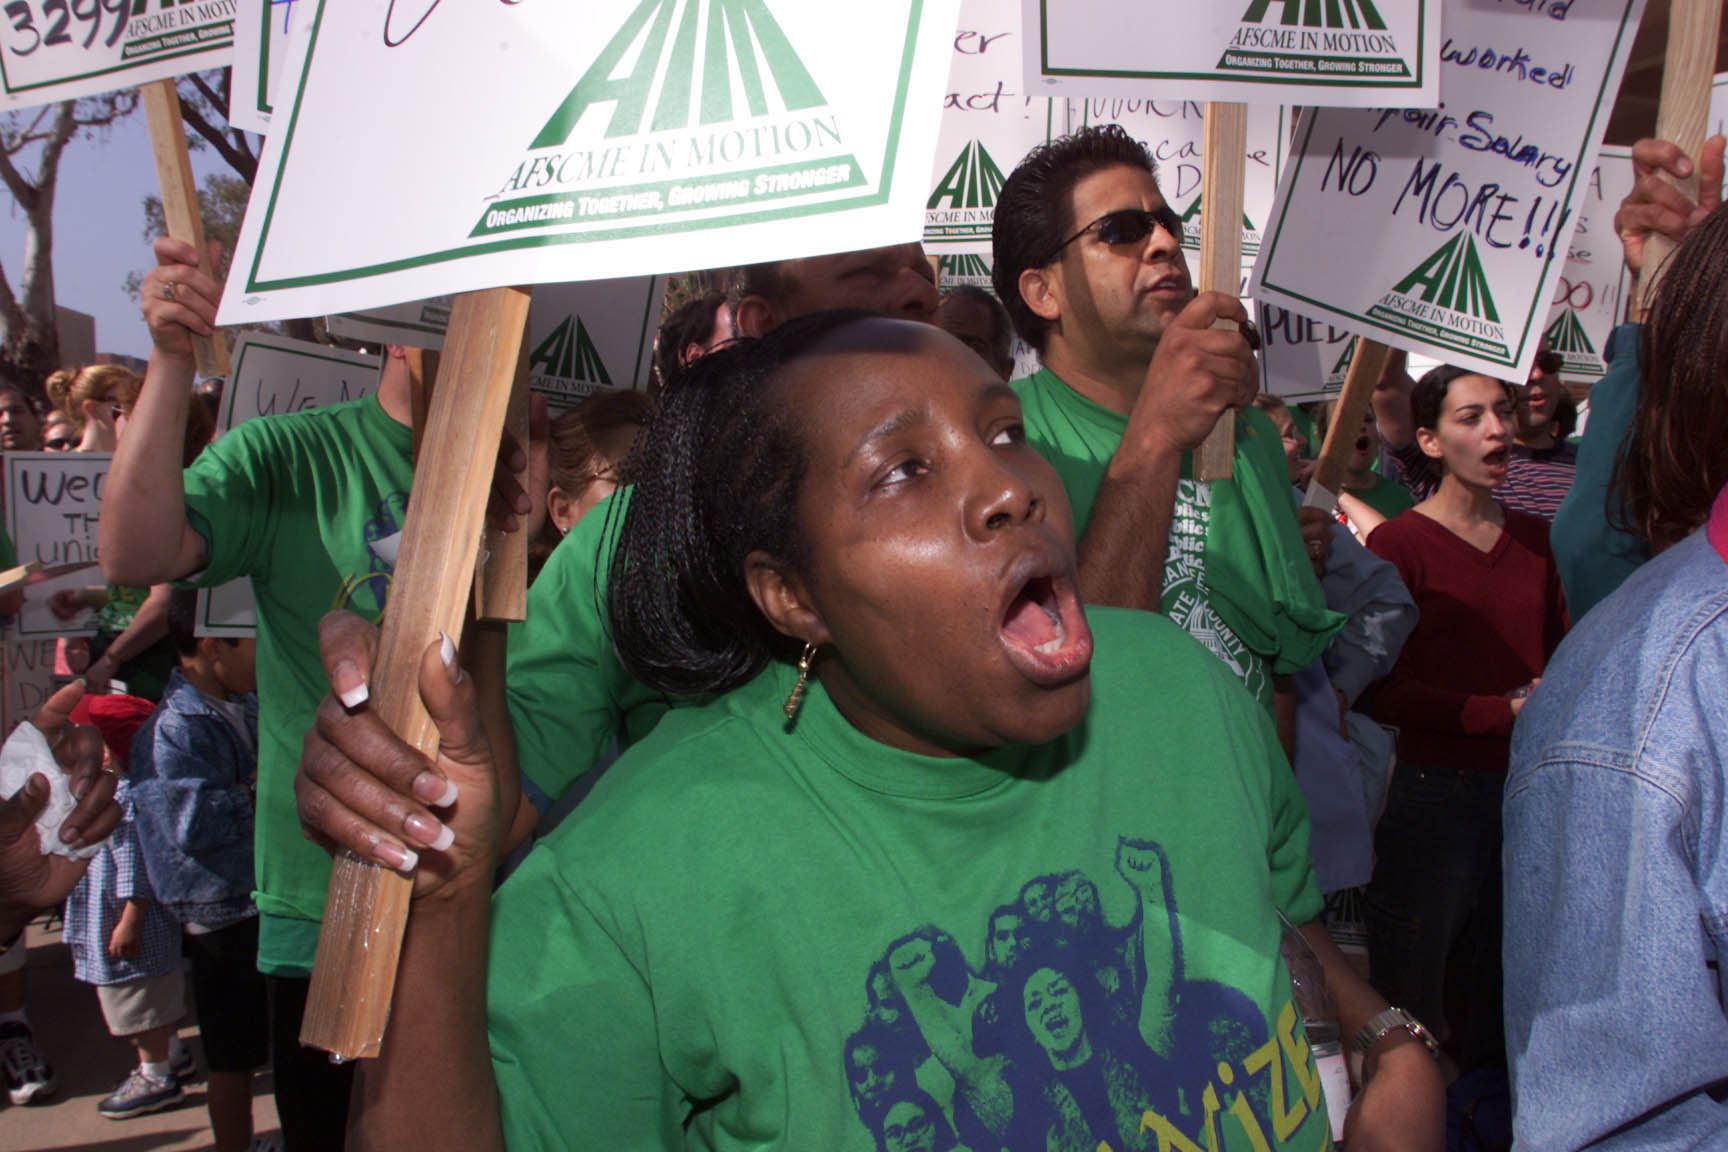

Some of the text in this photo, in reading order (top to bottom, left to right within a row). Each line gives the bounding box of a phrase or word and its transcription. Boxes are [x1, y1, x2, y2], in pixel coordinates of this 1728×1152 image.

[4, 0, 130, 56] 3299
[178, 5, 195, 25] IN
[197, 0, 237, 21] MOTI
[1229, 28, 1398, 53] AFSCME IN MOTION
[1225, 54, 1403, 73] ORGANIZING TOGETHER, GROWING STRONGER
[499, 114, 844, 194] AFSCME IN MOTION
[1321, 137, 1381, 197] NO
[1459, 111, 1572, 188] Salary
[486, 163, 851, 229] ORGANIZING TOGETHER, GROWING STRONGER
[1378, 293, 1506, 341] AFSCME IN MOTION
